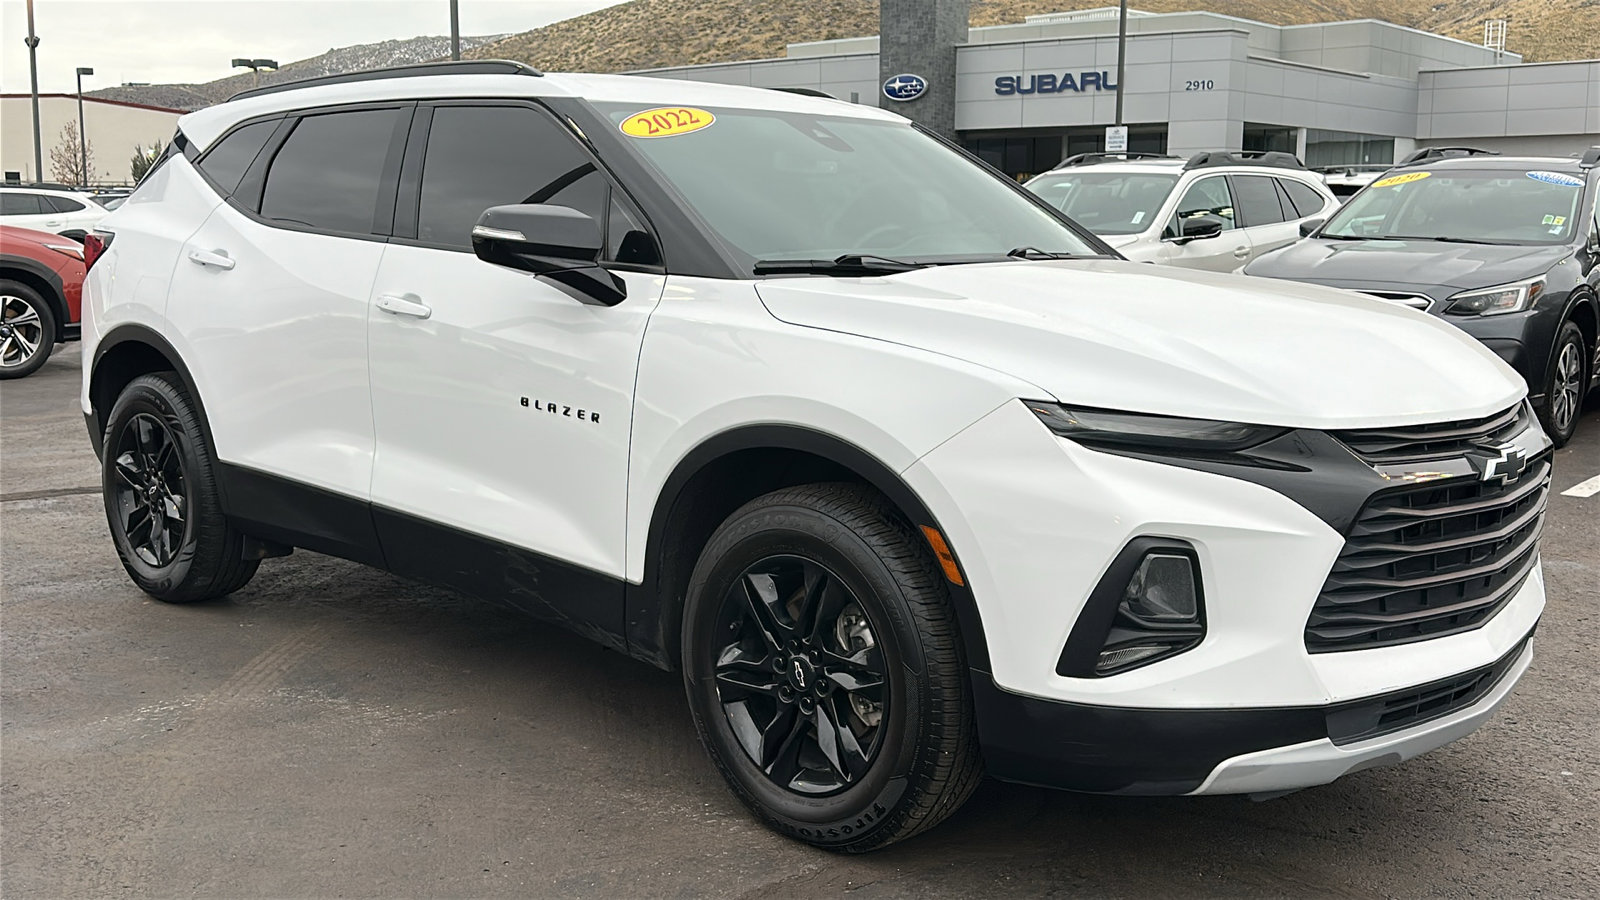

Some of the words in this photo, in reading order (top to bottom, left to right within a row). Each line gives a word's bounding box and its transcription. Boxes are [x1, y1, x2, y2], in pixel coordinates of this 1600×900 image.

[1185, 80, 1214, 91] 2910
[638, 109, 700, 134] 2022
[520, 396, 600, 423] BLAZER
